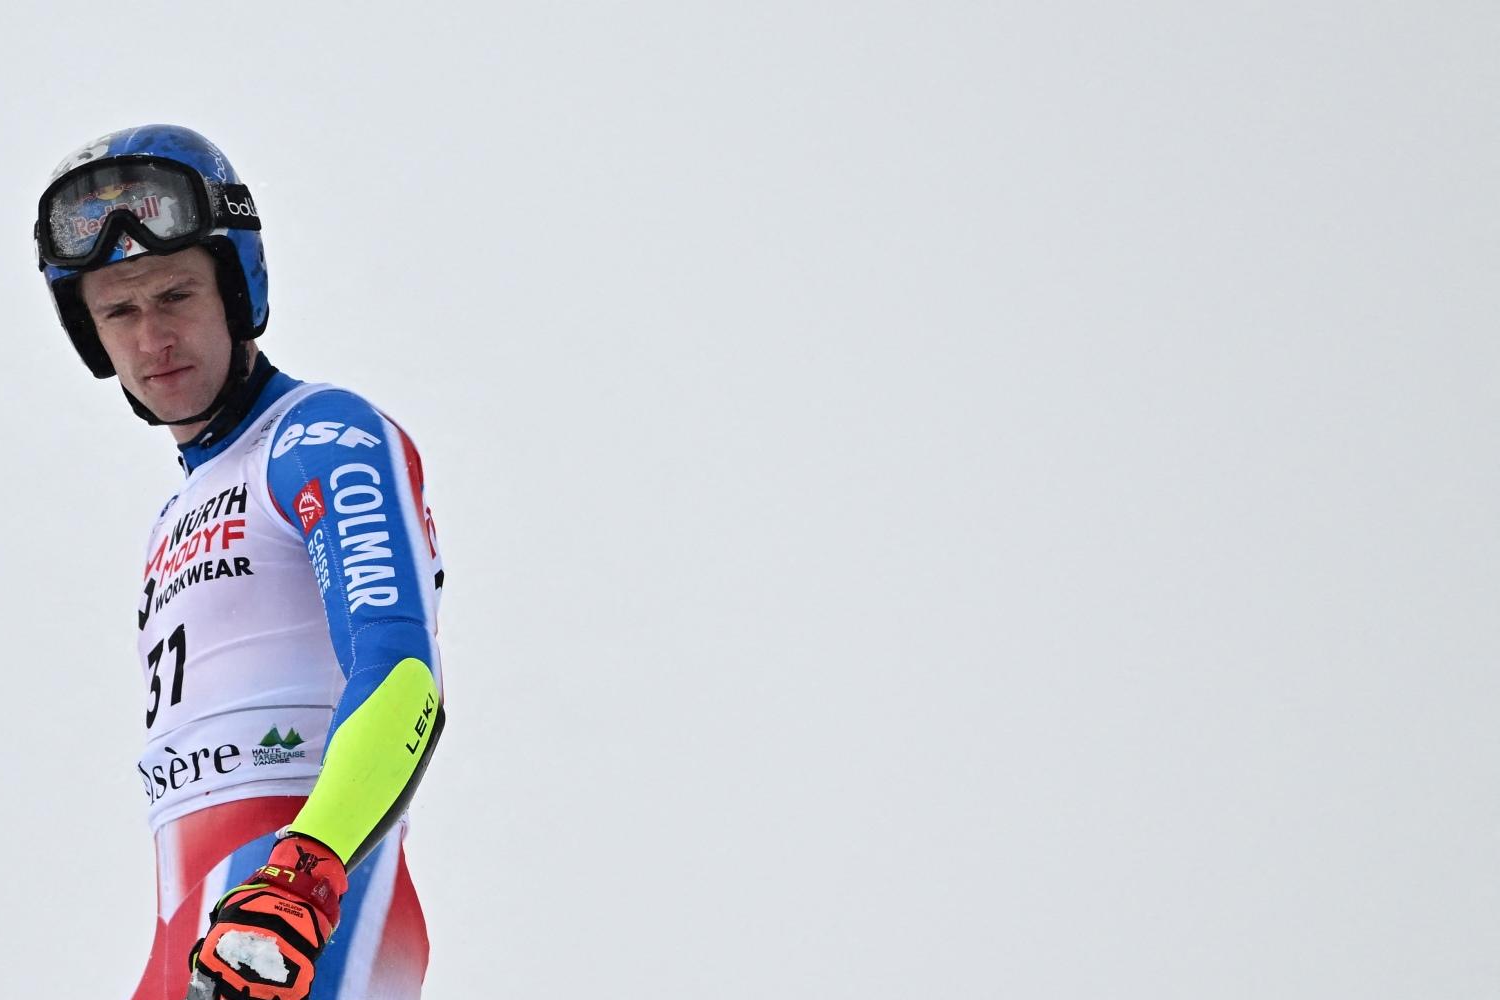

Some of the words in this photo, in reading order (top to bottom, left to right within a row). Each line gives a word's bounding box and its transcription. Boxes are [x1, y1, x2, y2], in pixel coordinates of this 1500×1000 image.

[158, 519, 246, 588] MODYF
[313, 528, 331, 594] CAISSE
[329, 463, 399, 614] COLMAR
[155, 557, 255, 614] WORKWEAR
[145, 623, 187, 729] 31
[252, 748, 281, 756] HAUTE
[405, 692, 435, 755] LEKI
[253, 751, 306, 761] TARENTAISE
